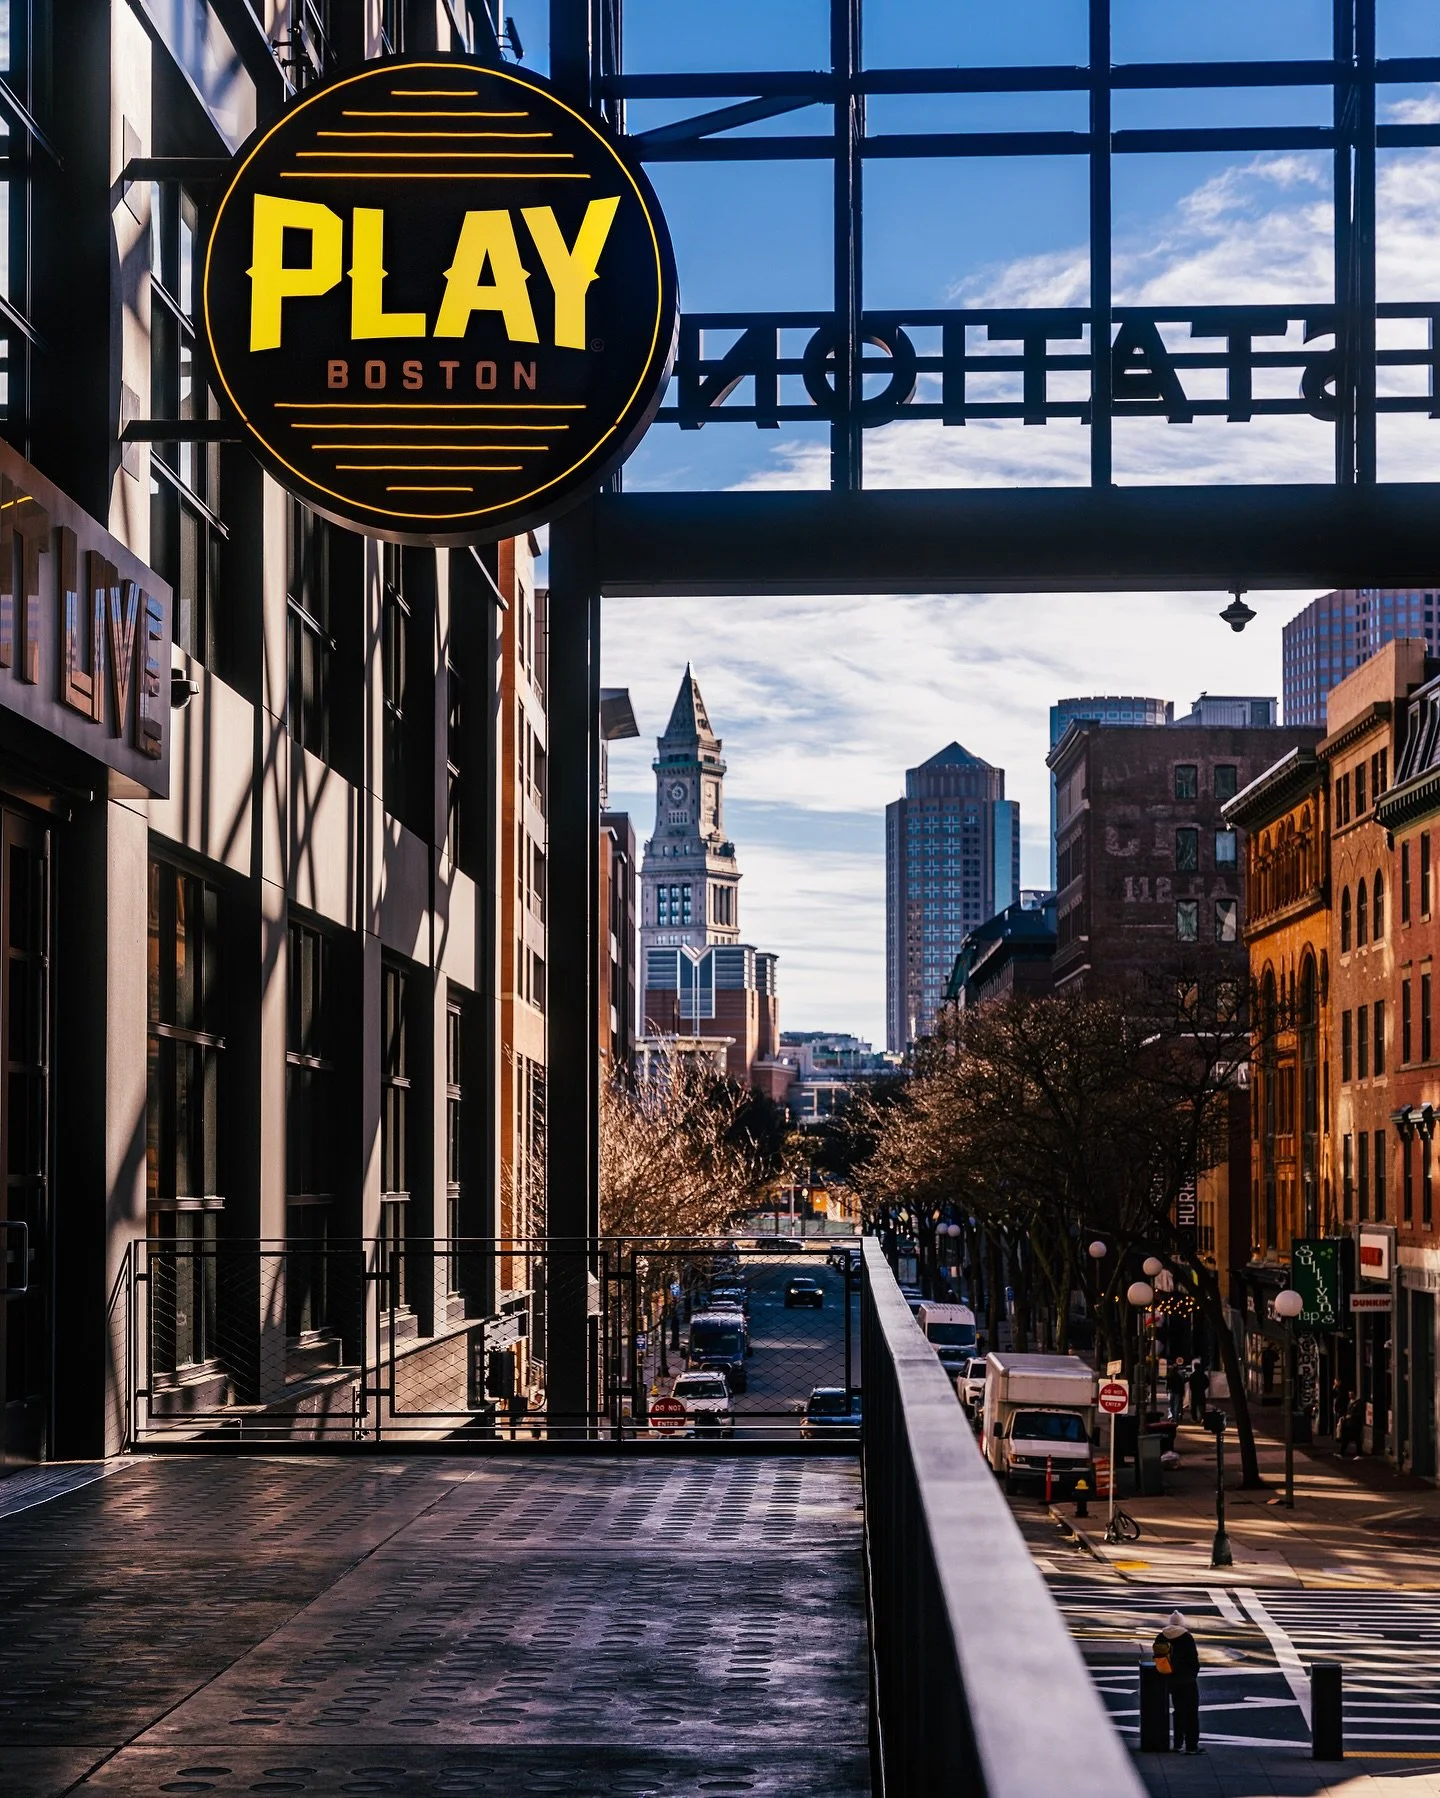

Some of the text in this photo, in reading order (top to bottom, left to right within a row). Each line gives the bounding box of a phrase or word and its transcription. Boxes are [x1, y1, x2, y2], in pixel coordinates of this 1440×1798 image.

[246, 193, 621, 353] PLAY
[327, 360, 537, 390] BOSTON
[57, 524, 163, 761] LIVE
[1295, 1245, 1336, 1324] Sullivan's
[1352, 1298, 1391, 1308] DUNKIN'
